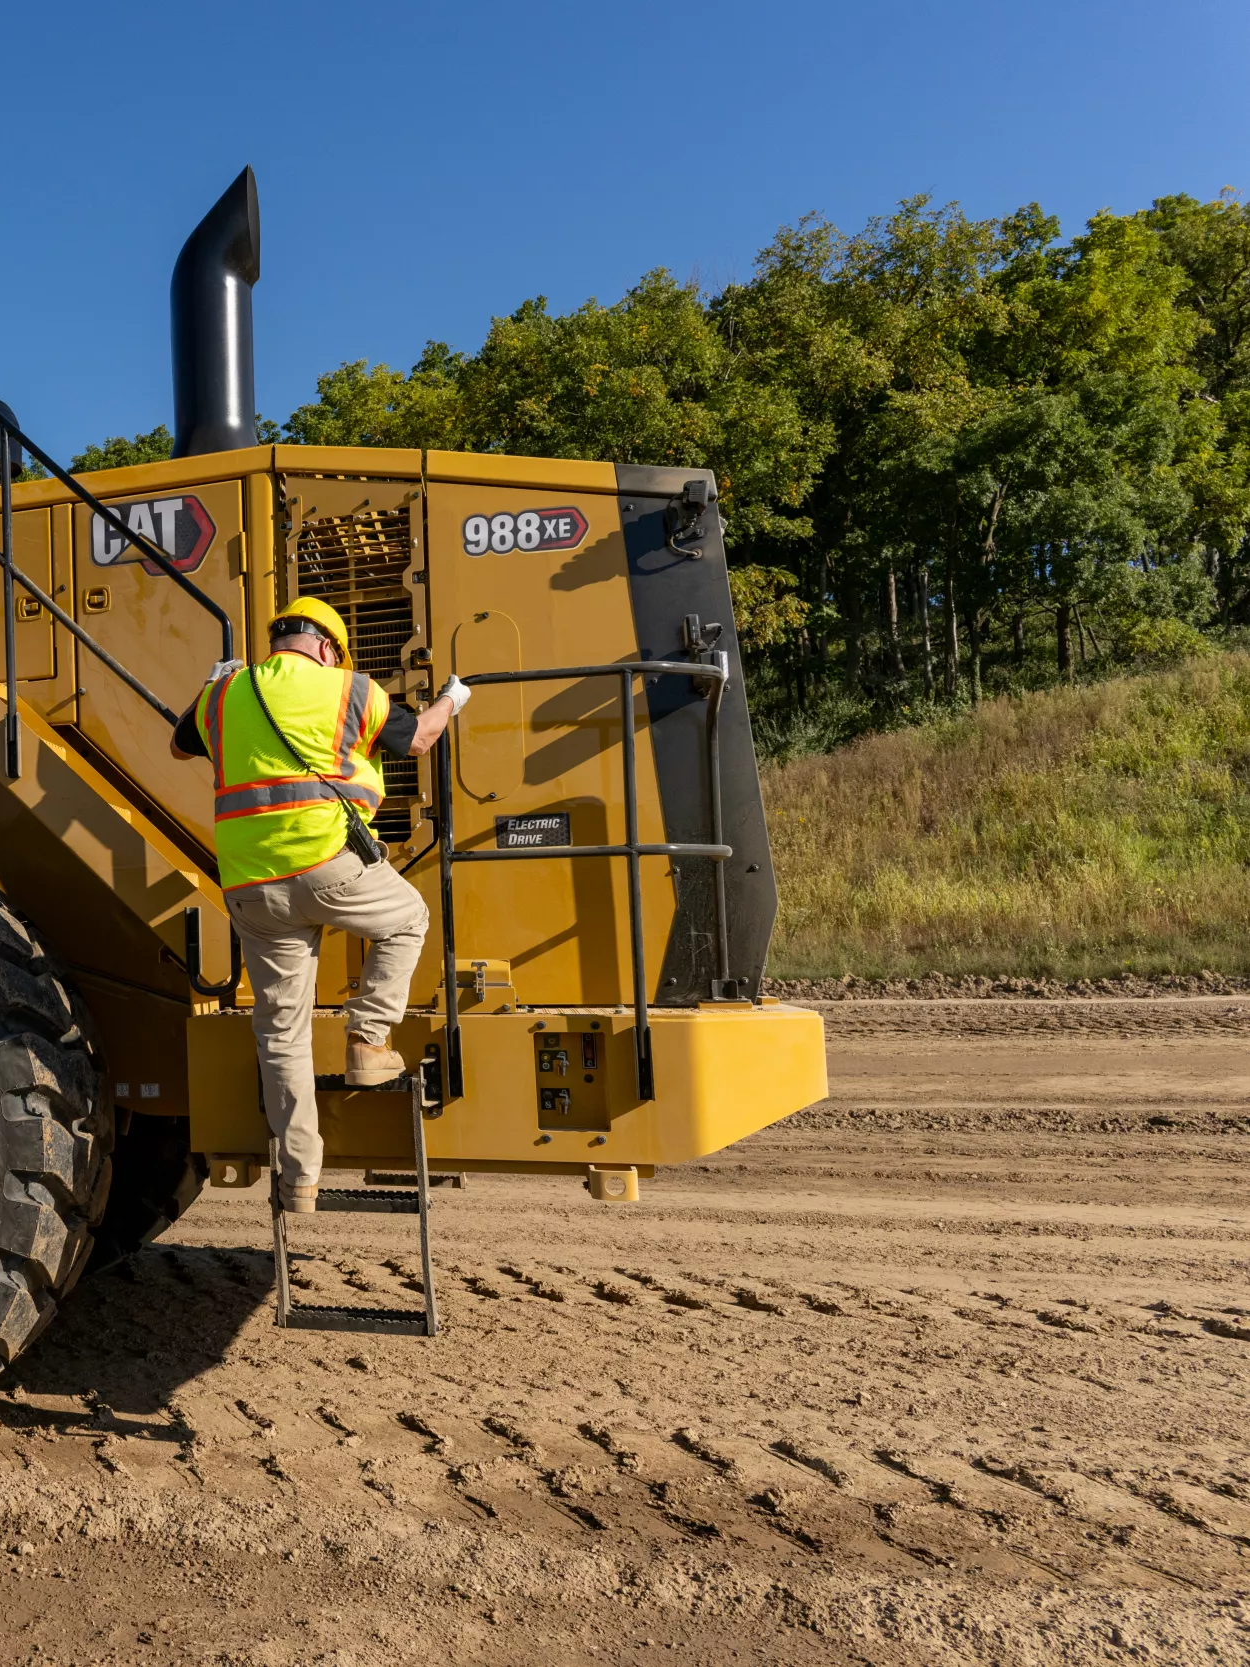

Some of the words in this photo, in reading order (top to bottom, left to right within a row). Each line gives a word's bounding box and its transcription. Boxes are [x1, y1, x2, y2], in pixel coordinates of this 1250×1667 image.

[92, 498, 183, 564] CAT
[507, 818, 560, 831] ELECTRIC
[508, 833, 543, 846] DRIVE
